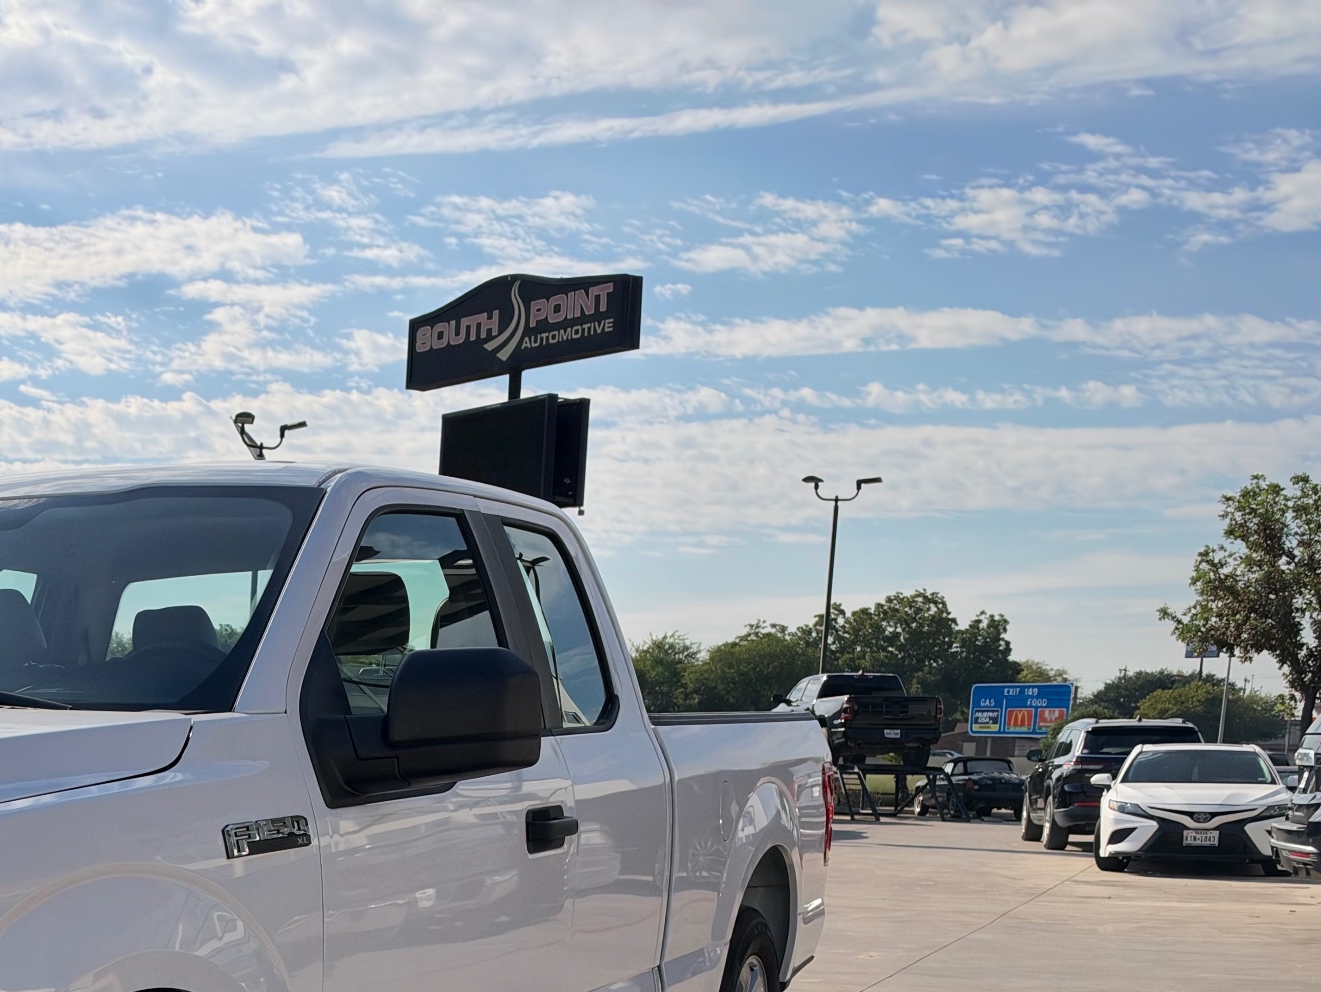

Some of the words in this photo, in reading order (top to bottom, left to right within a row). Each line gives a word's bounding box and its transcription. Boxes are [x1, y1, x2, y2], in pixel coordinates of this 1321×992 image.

[415, 309, 500, 353] SOUTH
[529, 282, 614, 328] POINT
[520, 318, 614, 350] AUTOMOTIVE
[1004, 687, 1020, 696] EXIT
[1024, 687, 1038, 696] 149
[980, 698, 995, 707] GAS
[1026, 698, 1048, 707] FOOD
[297, 836, 310, 845] XL
